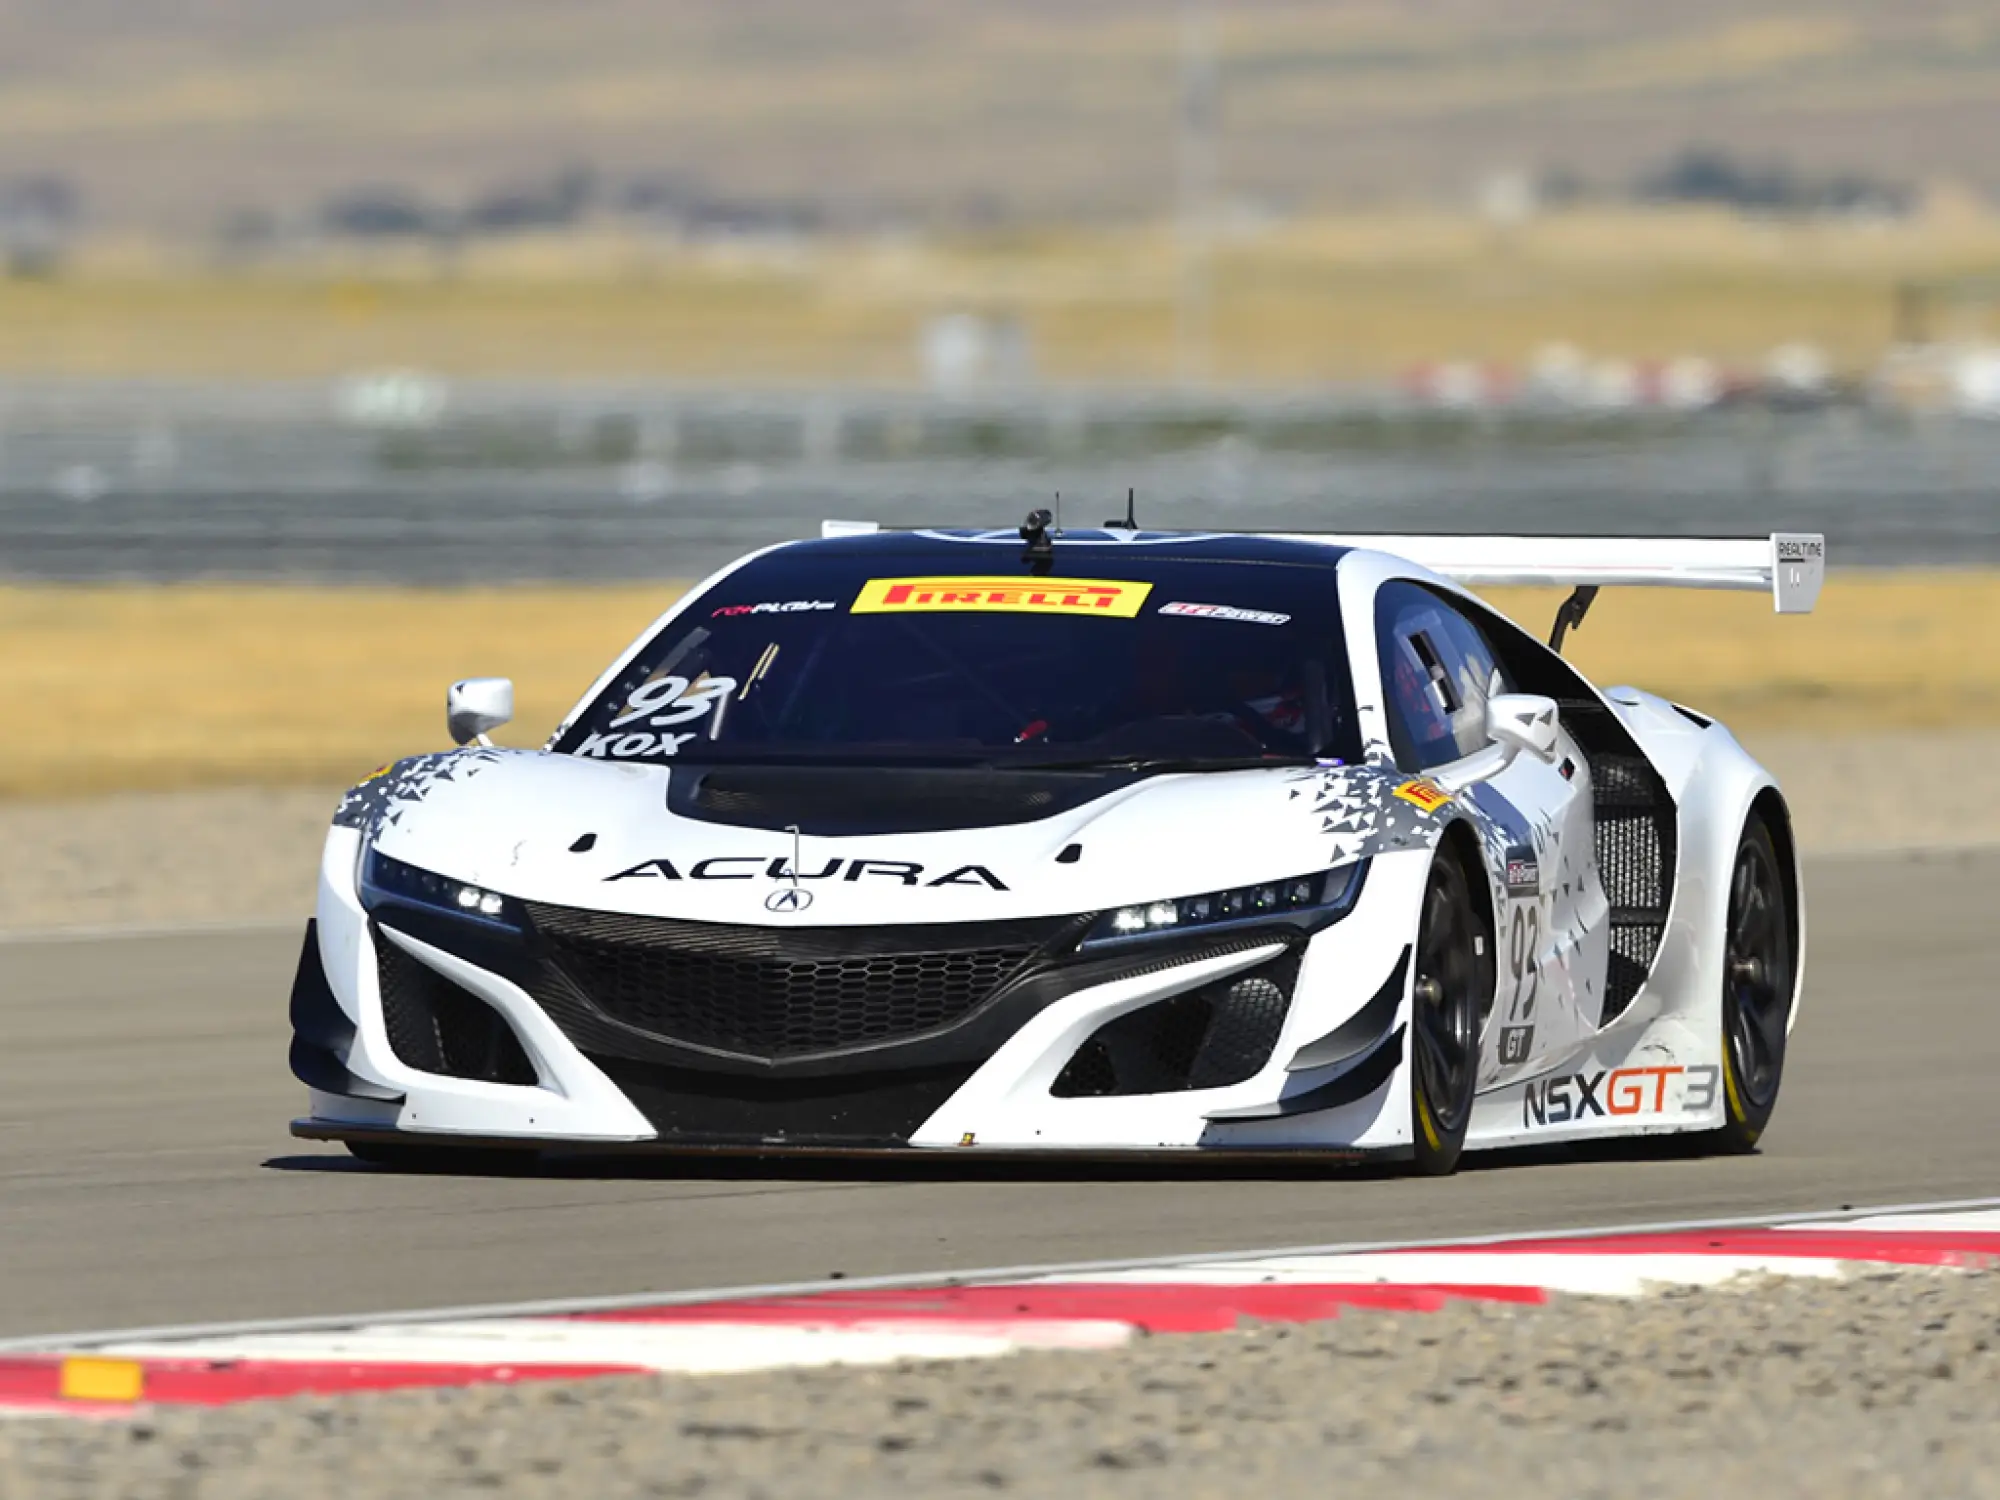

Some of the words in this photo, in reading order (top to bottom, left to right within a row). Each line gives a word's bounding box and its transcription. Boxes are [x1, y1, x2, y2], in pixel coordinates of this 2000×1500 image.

[1779, 543, 1821, 557] REALTIME
[883, 583, 1121, 609] PIRELLI
[609, 675, 737, 729] 93
[574, 731, 697, 758] KOX
[602, 857, 1010, 891] ACURA
[1510, 904, 1538, 1021] 93
[1506, 1028, 1527, 1058] GT
